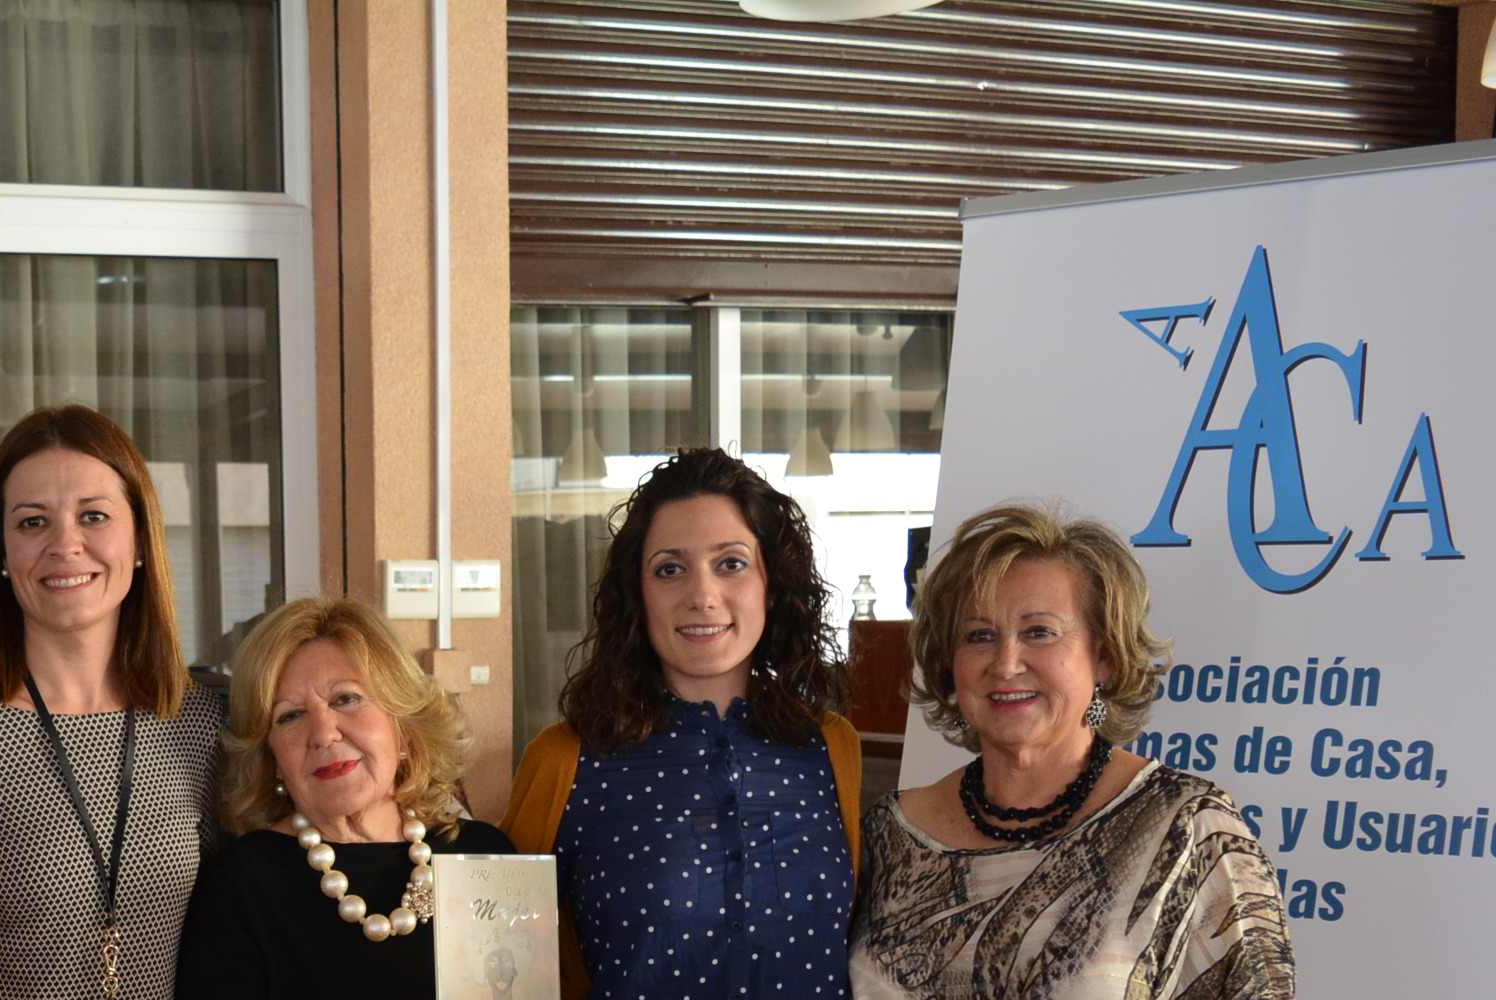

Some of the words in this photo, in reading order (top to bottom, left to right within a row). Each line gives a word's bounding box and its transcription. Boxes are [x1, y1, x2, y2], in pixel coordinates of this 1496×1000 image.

[1152, 656, 1381, 707] sociación
[1234, 726, 1292, 775] de
[1310, 728, 1448, 788] Casa,
[1278, 807, 1308, 852] y
